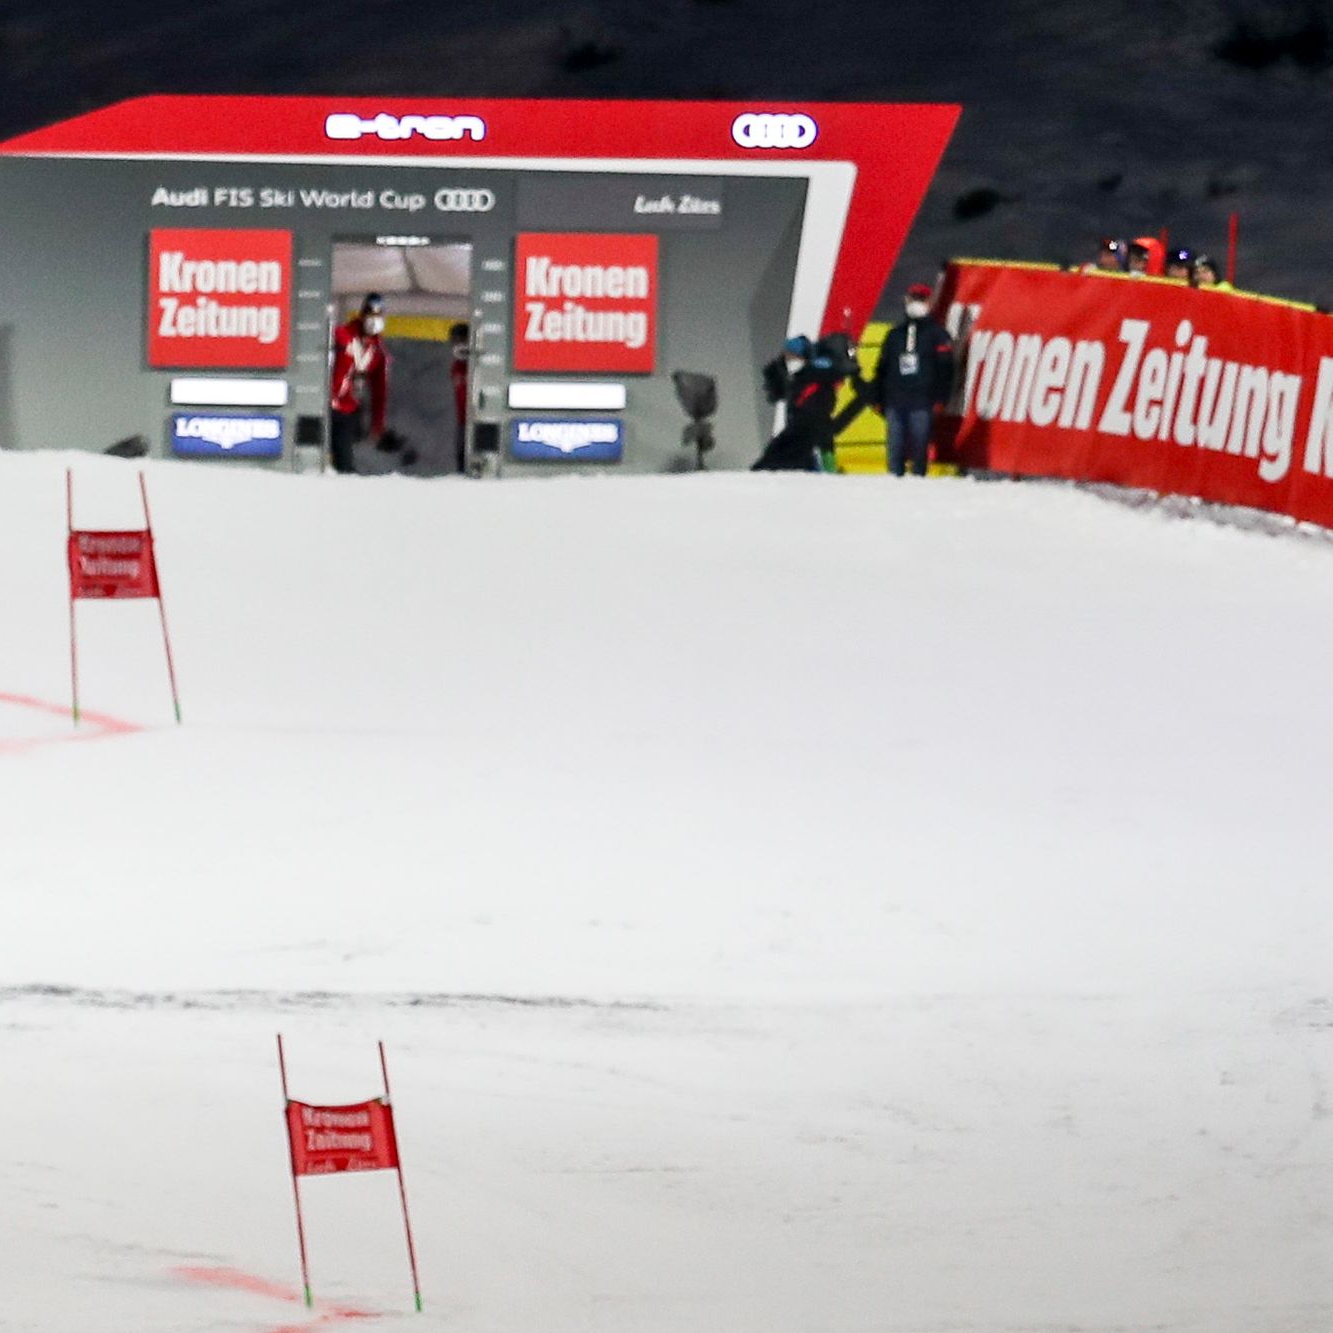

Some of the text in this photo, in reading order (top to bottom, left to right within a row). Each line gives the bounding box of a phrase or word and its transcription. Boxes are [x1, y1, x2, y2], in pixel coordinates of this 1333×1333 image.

[324, 112, 486, 141] e-tron
[151, 186, 427, 213] Audi FIS Ski World Cup
[158, 252, 282, 293] Kronen
[525, 256, 649, 298] Kronen
[158, 296, 280, 343] Zeitung
[524, 301, 648, 349] Zeitung
[946, 302, 1106, 430] ronen
[1097, 319, 1303, 483] Zeitung
